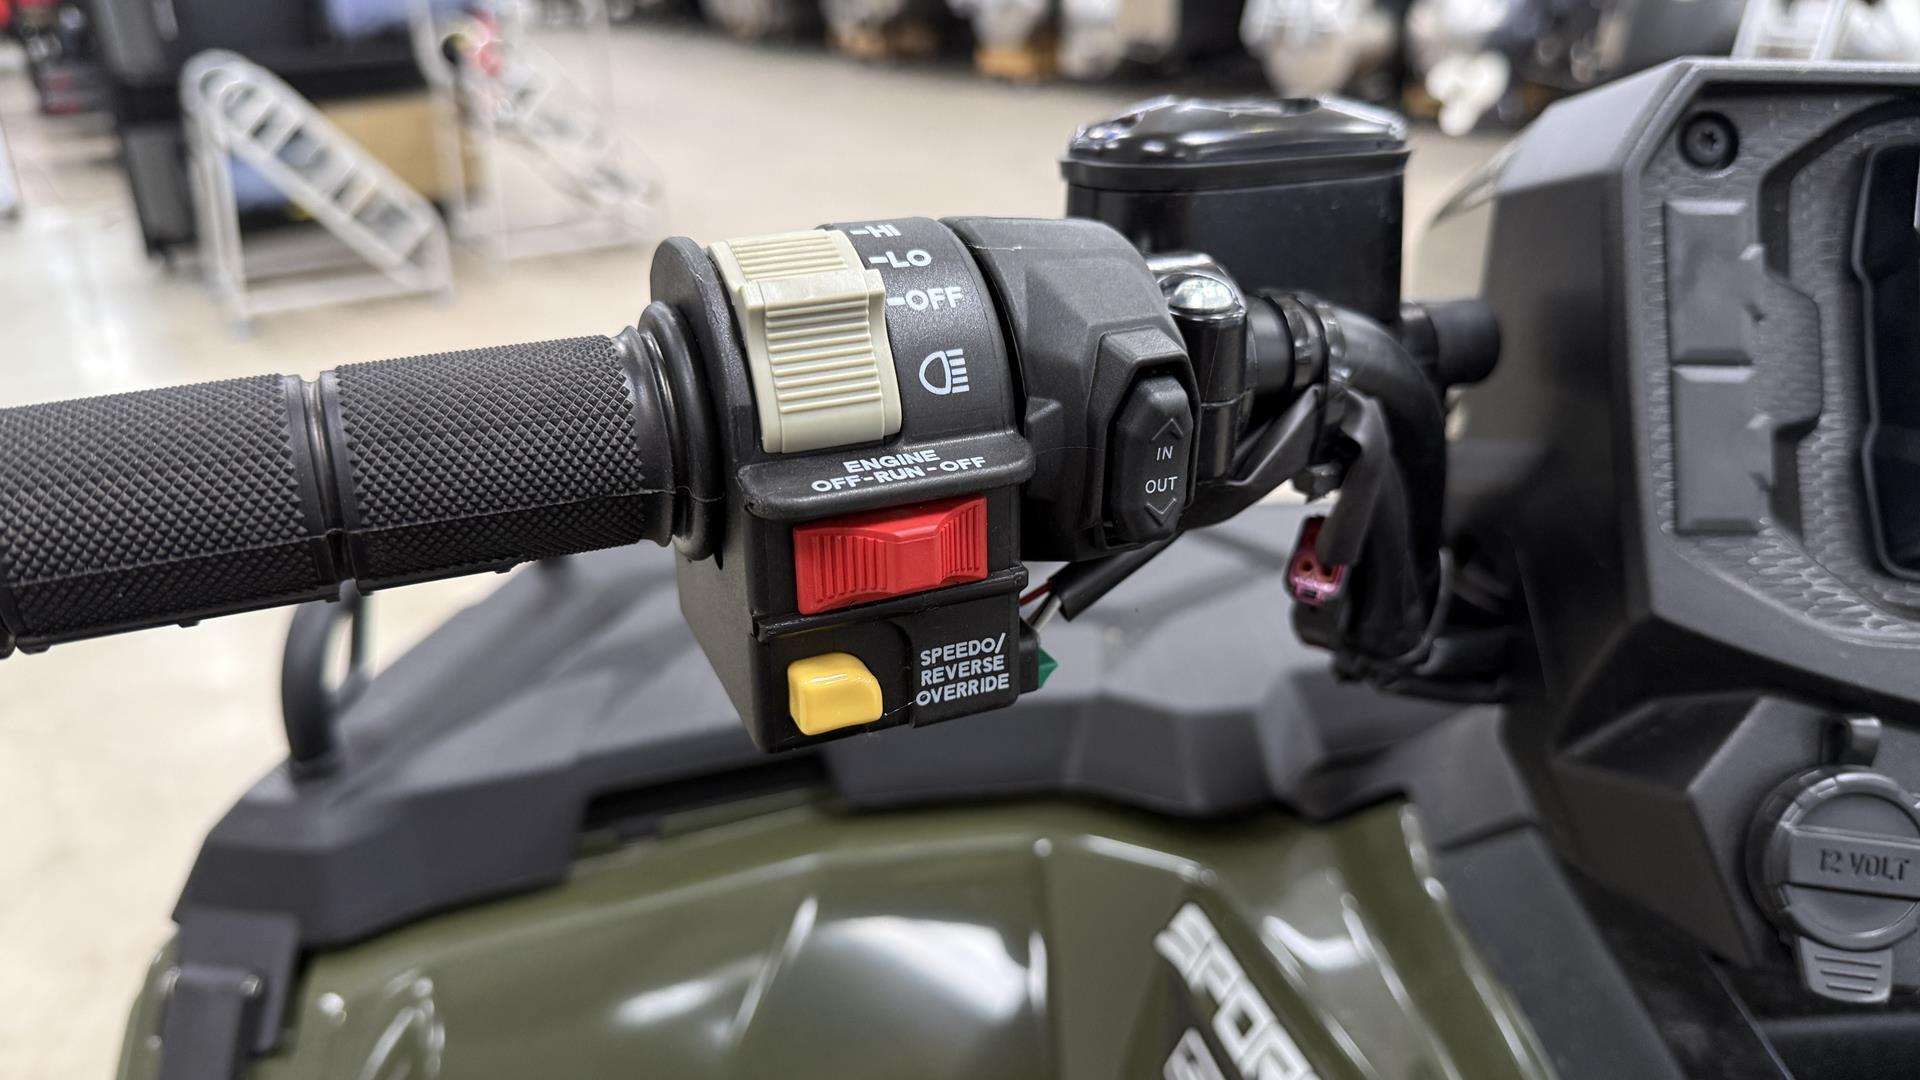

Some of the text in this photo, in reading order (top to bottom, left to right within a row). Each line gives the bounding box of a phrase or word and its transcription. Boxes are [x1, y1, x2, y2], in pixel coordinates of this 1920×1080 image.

[842, 449, 941, 474] ENGINE
[1156, 445, 1174, 461] IN
[1145, 476, 1178, 494] OUT
[920, 632, 1007, 666] SPEEDO/
[920, 654, 1005, 687] REVERSE
[916, 673, 1010, 706] OVERRIDE
[1820, 848, 1910, 881] 12 VOLT
[1153, 901, 1323, 1080] SPOR
